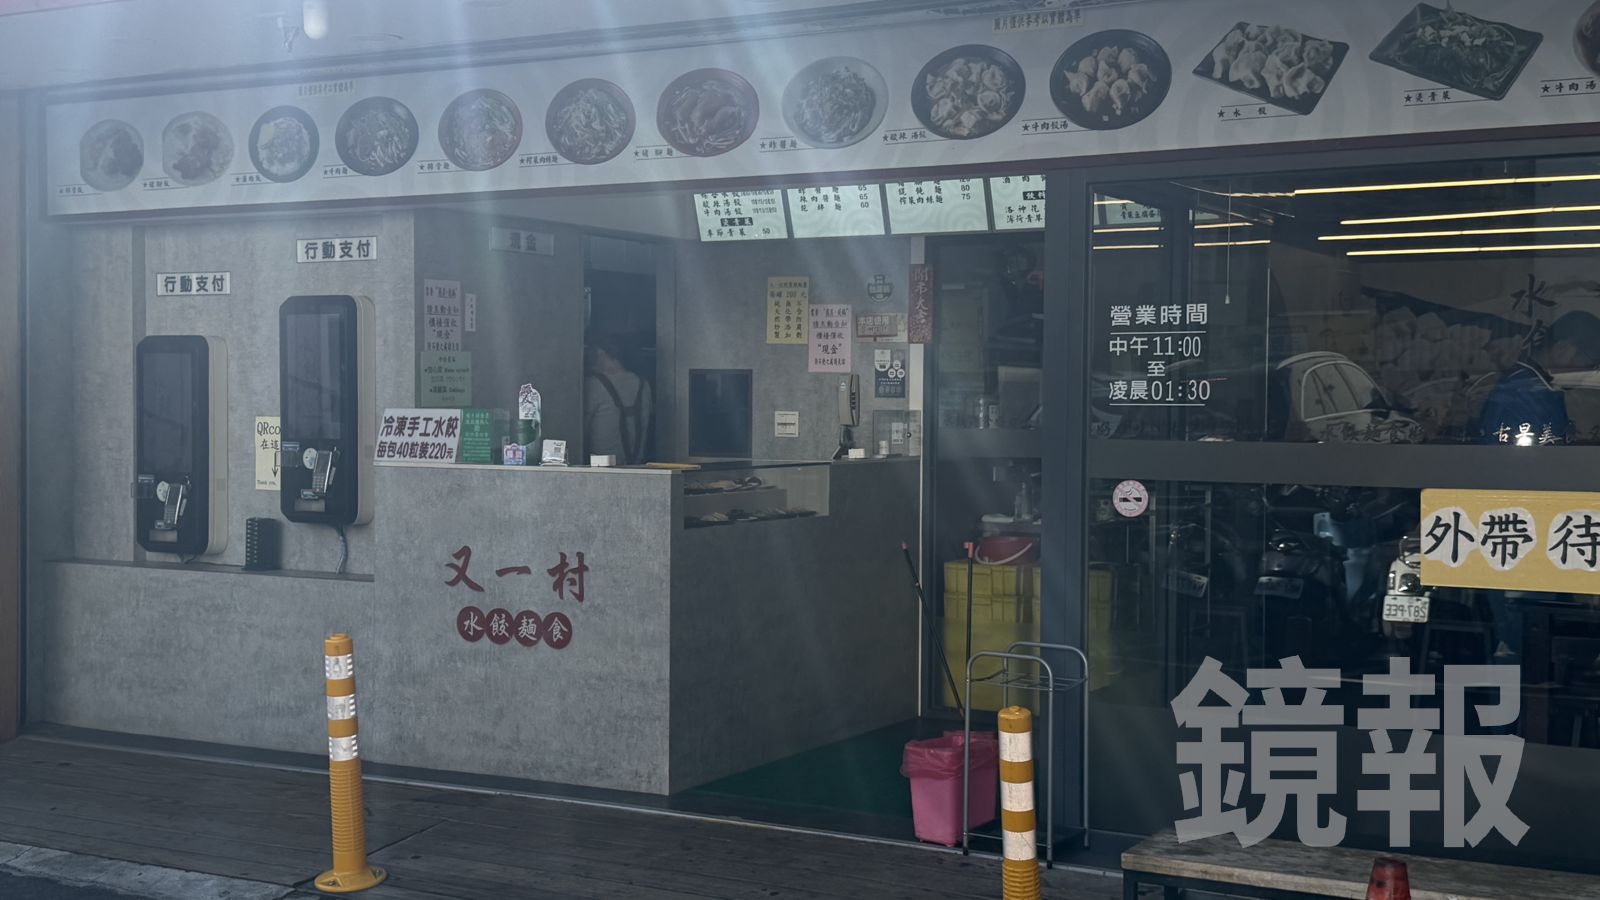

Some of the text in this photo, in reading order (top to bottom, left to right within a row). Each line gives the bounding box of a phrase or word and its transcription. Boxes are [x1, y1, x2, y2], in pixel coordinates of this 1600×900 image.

[1555, 80, 1597, 92] 牛肉湯
[304, 239, 371, 260] 行動支付
[164, 275, 225, 293] 行動支付
[1110, 303, 1208, 327] 營業時間
[1147, 360, 1166, 377] 至
[380, 416, 460, 438] 冷凍手工水餃
[377, 440, 454, 460] 每包40粒裝220元
[444, 545, 589, 603] 又一村
[463, 611, 569, 642] 水餃麵食
